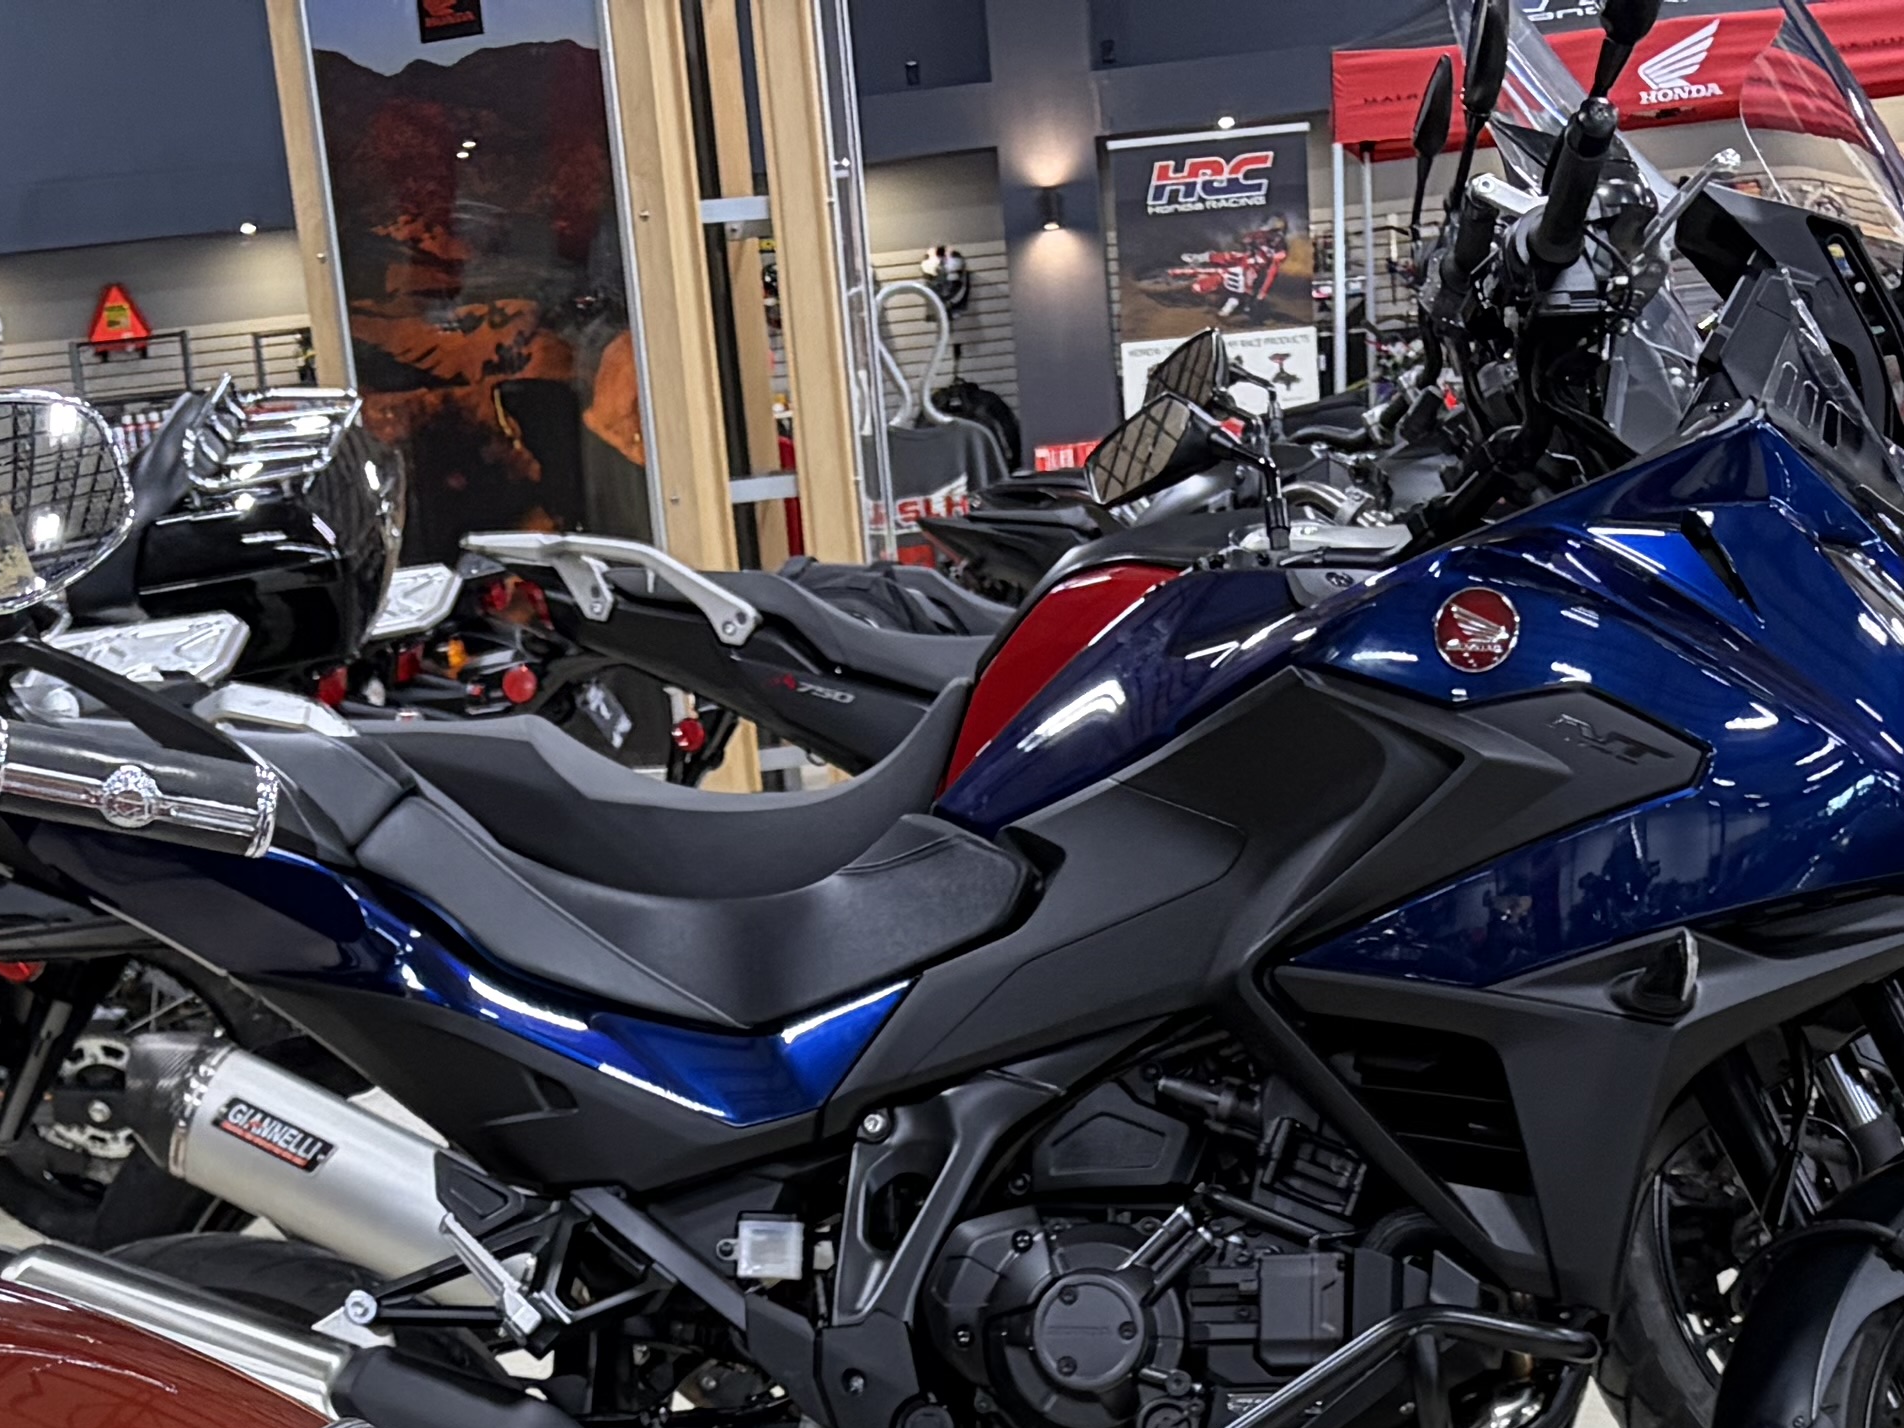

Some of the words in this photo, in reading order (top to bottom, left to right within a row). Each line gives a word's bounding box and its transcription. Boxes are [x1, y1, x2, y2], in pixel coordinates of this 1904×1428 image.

[1639, 82, 1723, 105] HONDA
[1146, 151, 1275, 205] HRC
[227, 1102, 324, 1161] GIANNELLI
